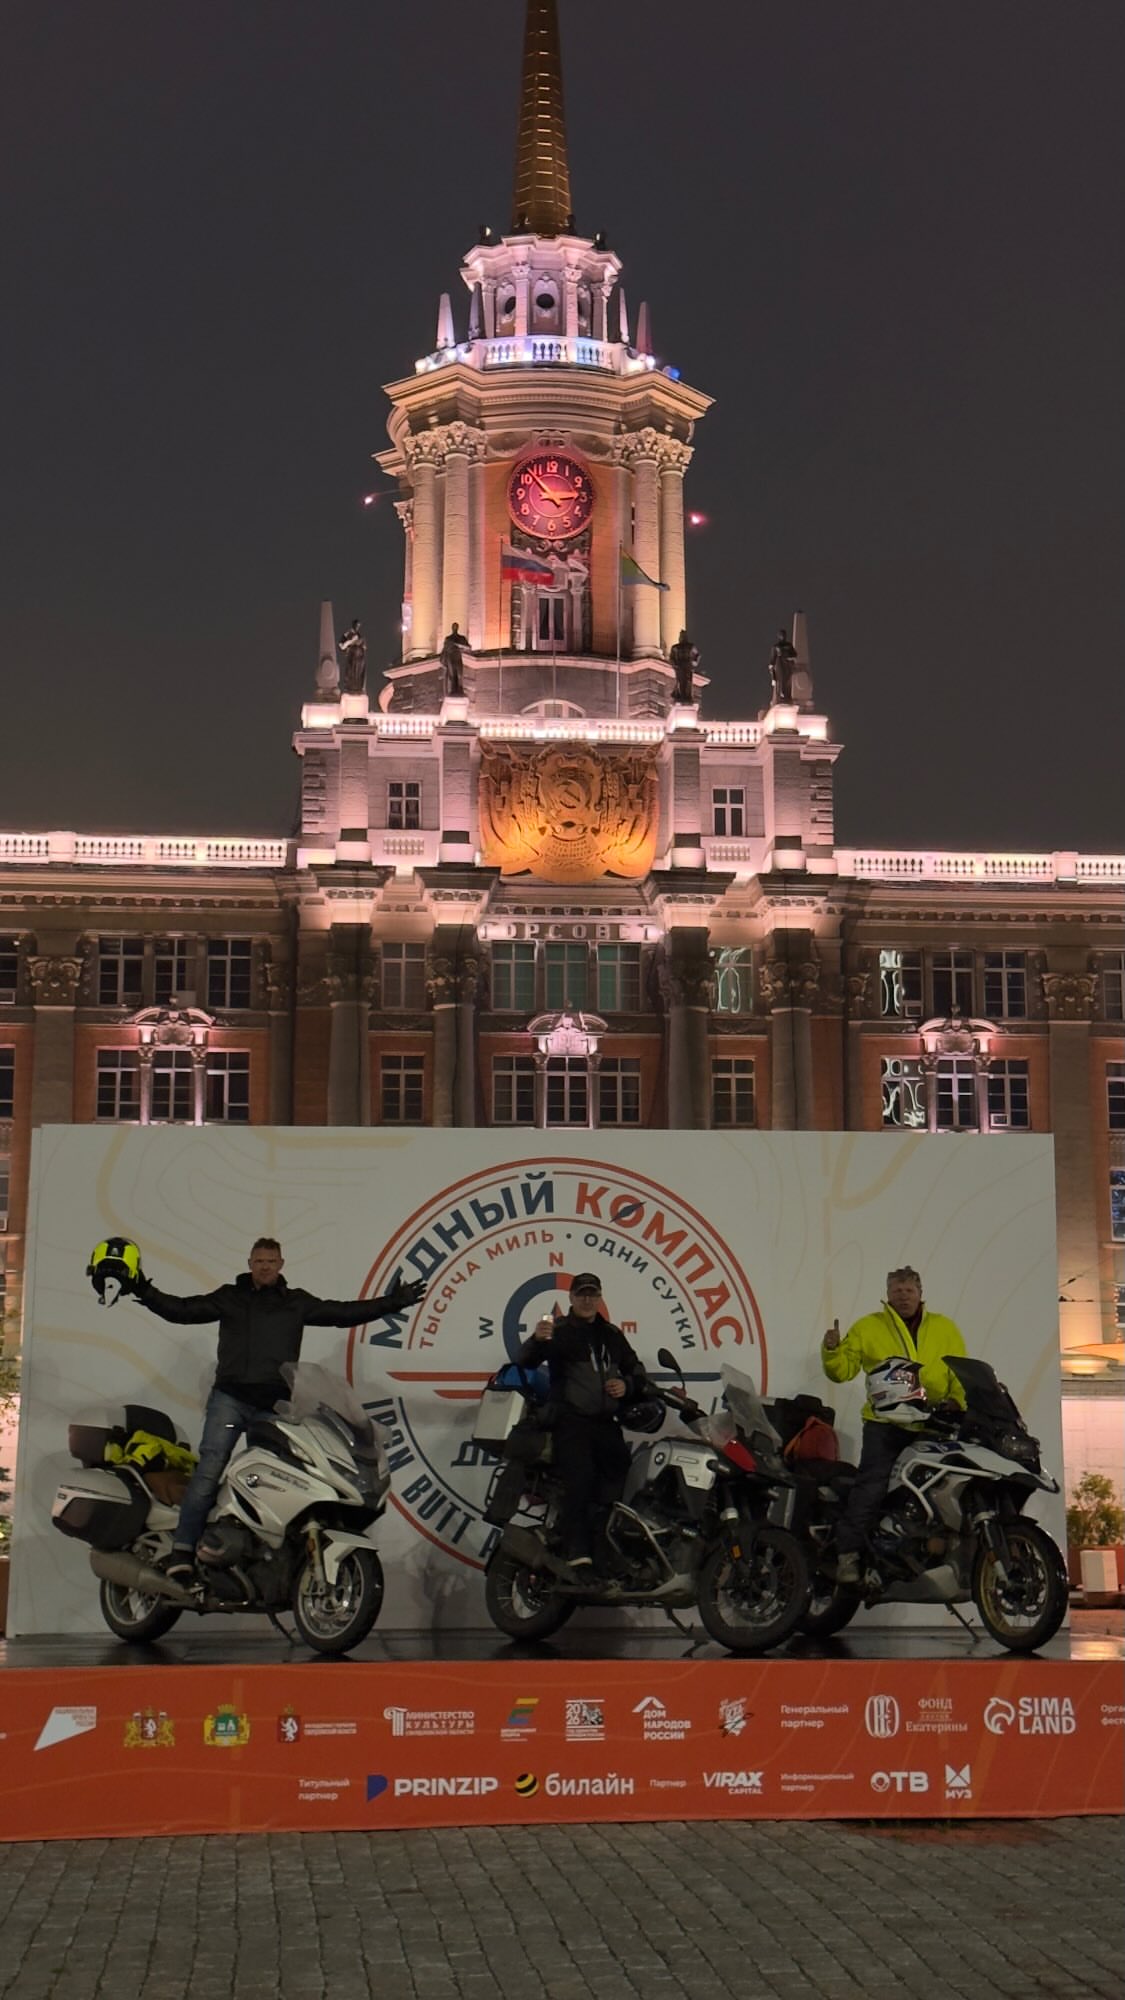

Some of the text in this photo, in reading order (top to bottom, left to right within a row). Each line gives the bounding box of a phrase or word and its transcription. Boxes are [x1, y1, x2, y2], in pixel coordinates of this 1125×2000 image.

[546, 460, 559, 473] 12
[564, 464, 570, 477] 1
[520, 473, 533, 485] 10
[574, 475, 583, 488] 2
[516, 487, 526, 500] 9
[580, 491, 588, 503] 3
[520, 502, 530, 516] 8
[573, 505, 582, 518] 4
[532, 514, 541, 526] 7
[547, 518, 557, 531] 6
[562, 515, 572, 528] 5
[549, 1251, 564, 1267] N
[575, 1181, 744, 1349] КОМПАС
[419, 1229, 696, 1349] ТЫСЯЧА МИЛЬ ОДНИ СУТКИ
[479, 1316, 494, 1340] W
[401, 1473, 477, 1545] BUTT
[780, 1704, 849, 1714] Генеральный
[917, 1697, 953, 1710] ФОНД
[1018, 1696, 1075, 1717] SIMA
[643, 1710, 667, 1719] ДОМ
[405, 1720, 475, 1729] КУЛЬТУРЫ
[643, 1720, 692, 1729] НАРОДОВ
[780, 1719, 825, 1728] партнер
[905, 1721, 968, 1735] Екатерины
[1018, 1716, 1077, 1735] LAND
[643, 1731, 686, 1740] РОССИИ
[298, 1778, 351, 1790] Титульный
[545, 1772, 634, 1796] билайн
[649, 1779, 687, 1788] Партнер
[702, 1771, 764, 1788] VIRAX
[870, 1771, 929, 1793] ОТВ
[394, 1777, 499, 1797] PRINZIP
[727, 1787, 764, 1795] CAPITAL
[298, 1792, 339, 1801] партнер
[945, 1789, 973, 1799] МУЗ
